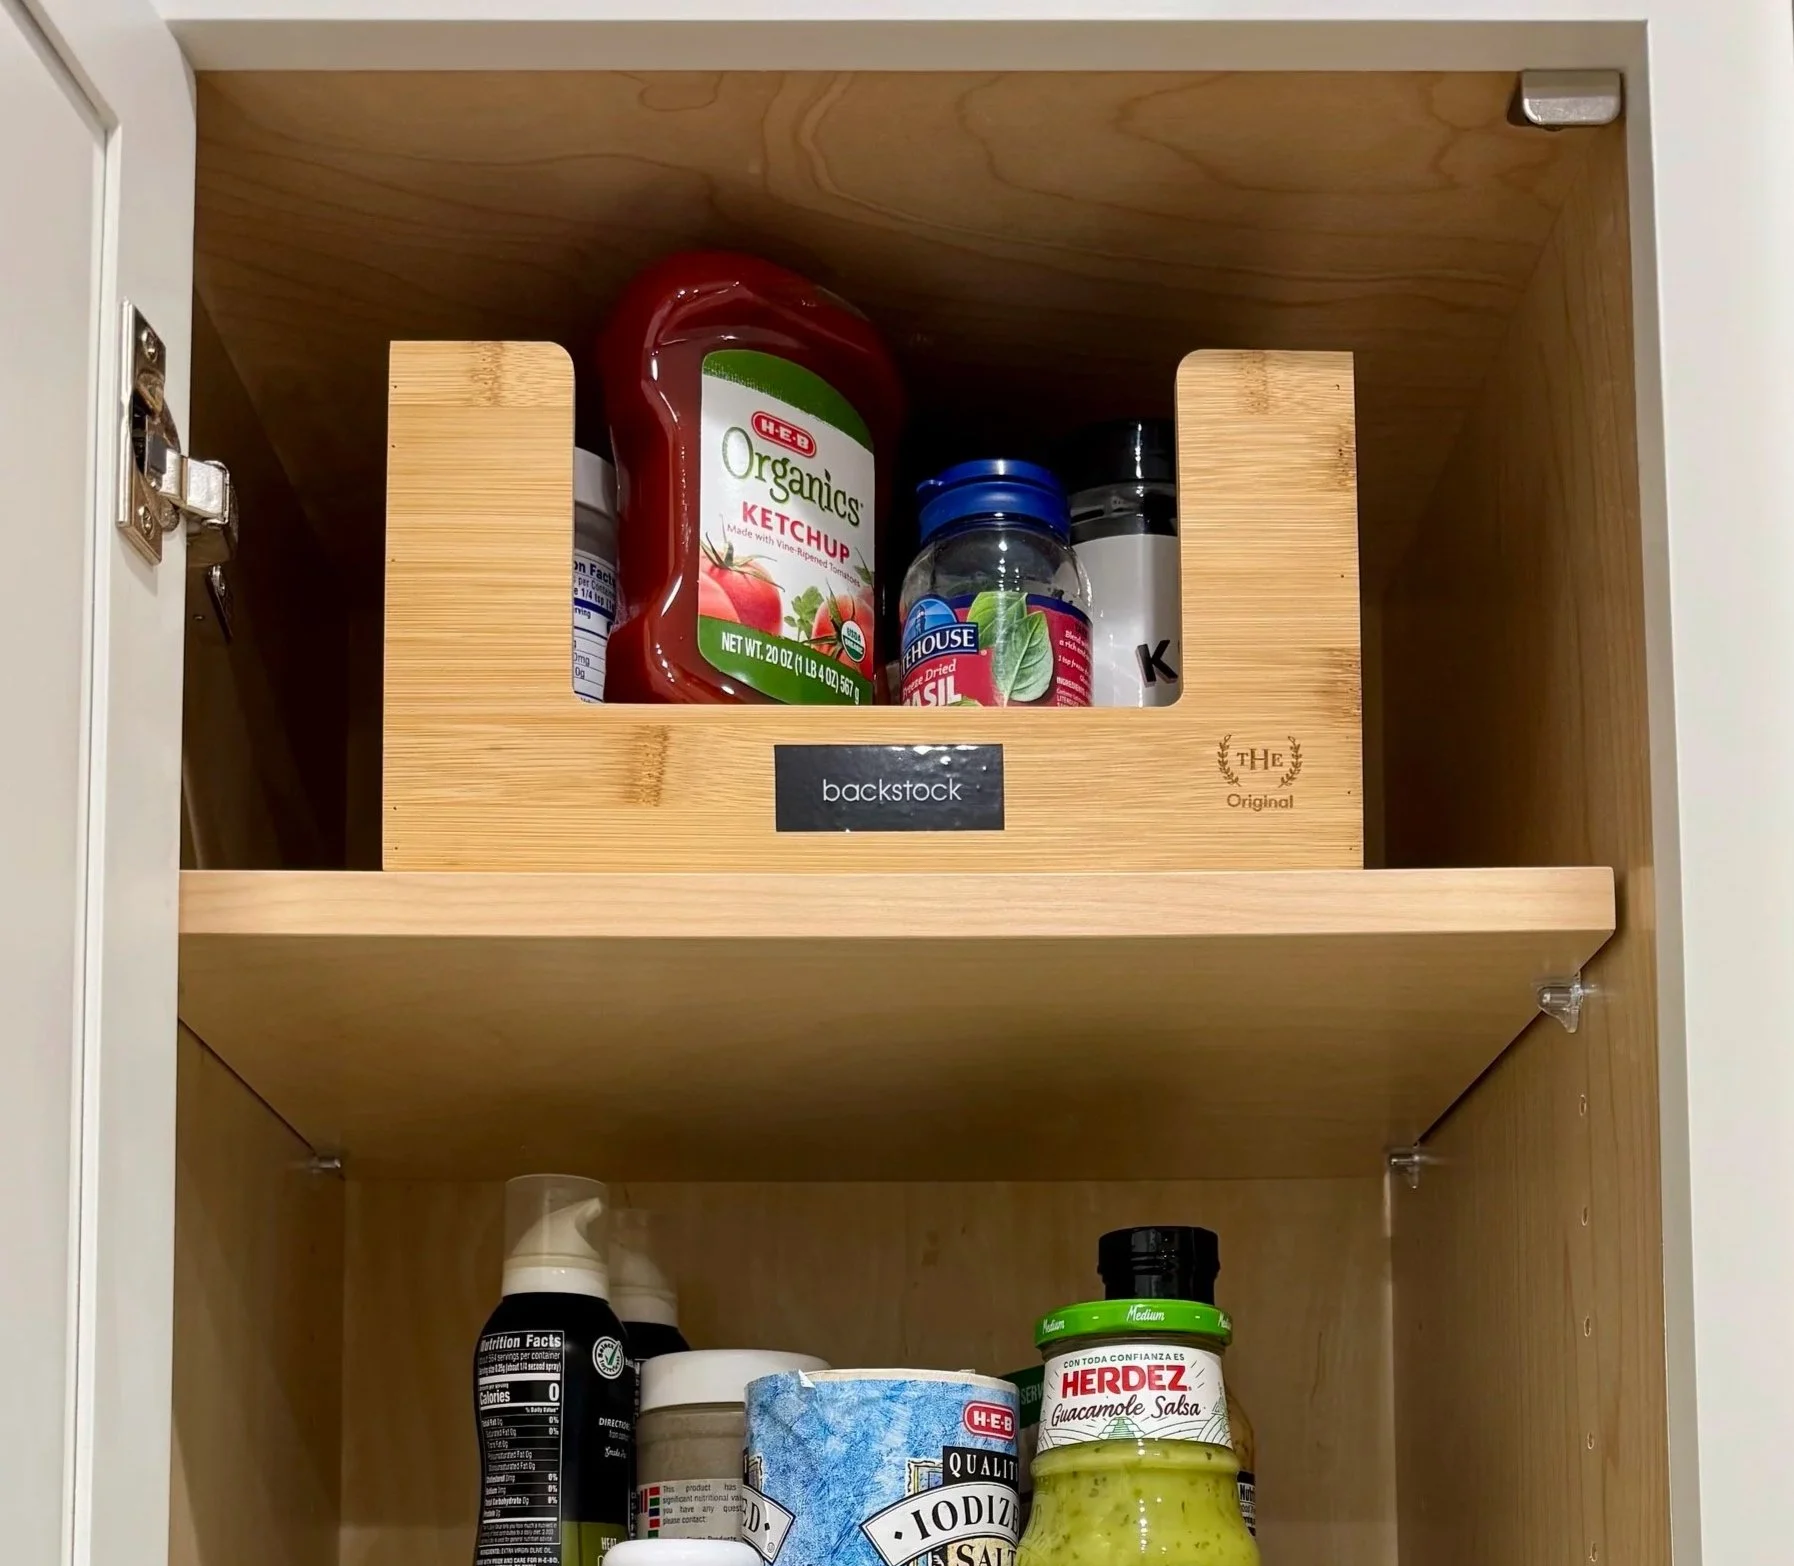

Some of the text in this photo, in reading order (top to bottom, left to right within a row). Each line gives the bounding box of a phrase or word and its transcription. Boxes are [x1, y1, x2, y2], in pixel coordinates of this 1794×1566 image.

[722, 427, 864, 528] Organics
[743, 501, 850, 564] KETCHUP
[726, 524, 755, 541] Made
[757, 535, 776, 549] with
[777, 540, 829, 571] Vine-Ripened
[722, 632, 863, 706] NET WT. 20 OZ (1 LB 4 OZ) 567 g
[925, 658, 957, 681] Dried
[1135, 640, 1178, 688] K
[1236, 749, 1284, 772] THE
[823, 779, 962, 801] backstock
[1226, 792, 1294, 818] Original
[1126, 1303, 1166, 1322] Medium
[1043, 1318, 1066, 1336] Medium
[481, 1334, 562, 1351] Nutrition Facts
[521, 1352, 531, 1361] per
[531, 1350, 561, 1361] container
[1063, 1352, 1186, 1369] CON TODA CONFIANZA ES
[1061, 1364, 1188, 1399] HERDEZ
[480, 1383, 560, 1406] Calories 0
[548, 1415, 560, 1424] 0%
[1051, 1394, 1201, 1428] Guacamole Salsa
[548, 1427, 560, 1435] 0%
[548, 1473, 558, 1481] 0%
[548, 1484, 558, 1493] 0%
[663, 1485, 675, 1493] This
[686, 1484, 711, 1493] product
[663, 1494, 729, 1506] significant nutritional
[680, 1506, 715, 1514] have any
[663, 1518, 681, 1526] please
